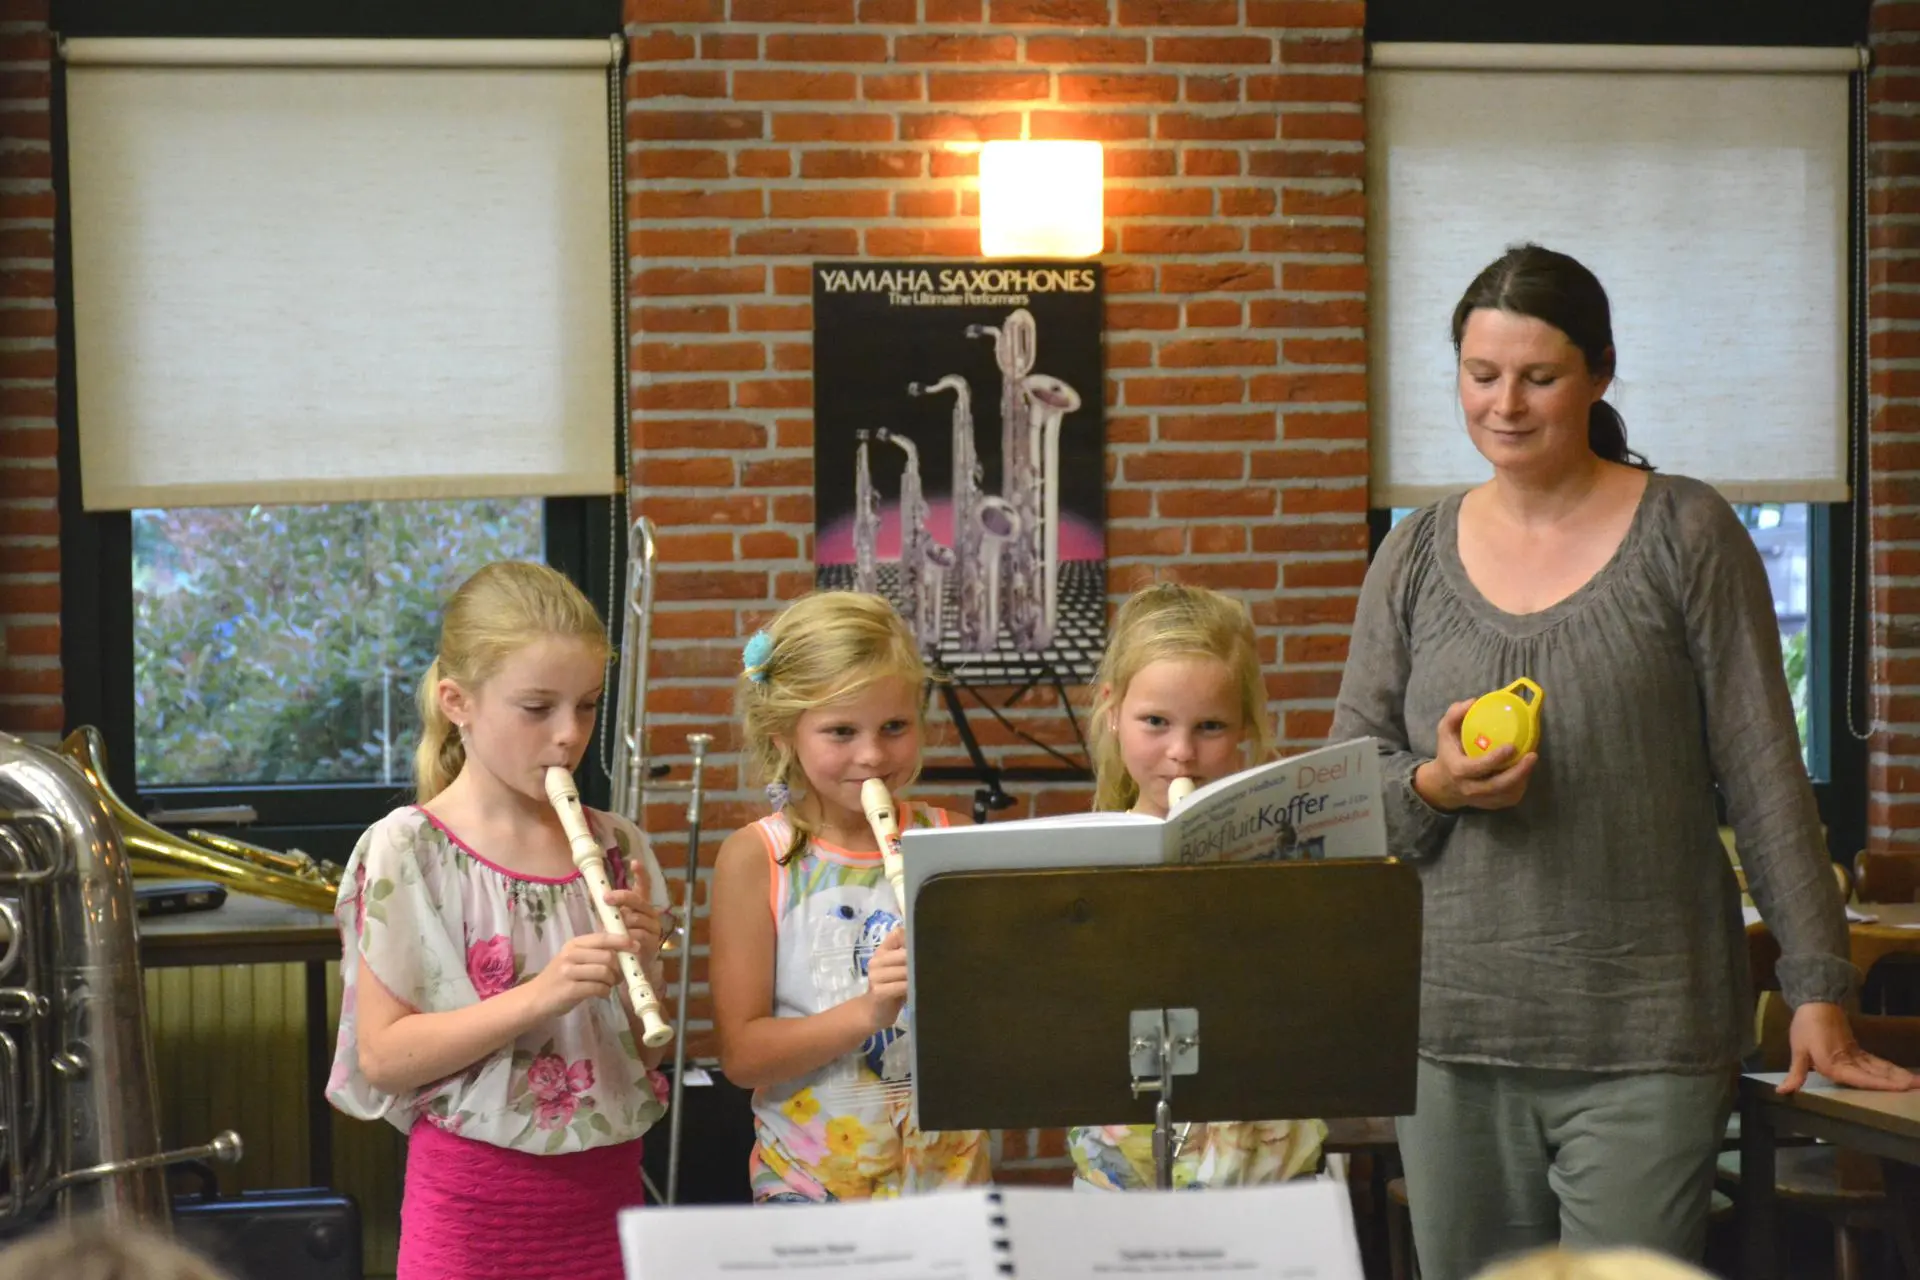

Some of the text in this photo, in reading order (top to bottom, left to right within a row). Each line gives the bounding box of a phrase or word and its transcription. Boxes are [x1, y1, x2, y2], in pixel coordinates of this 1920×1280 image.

[820, 269, 1095, 292] YAMAHA SAXOPHONES
[889, 292, 1029, 306] The Ultimate Performers
[1297, 755, 1348, 790] Deel
